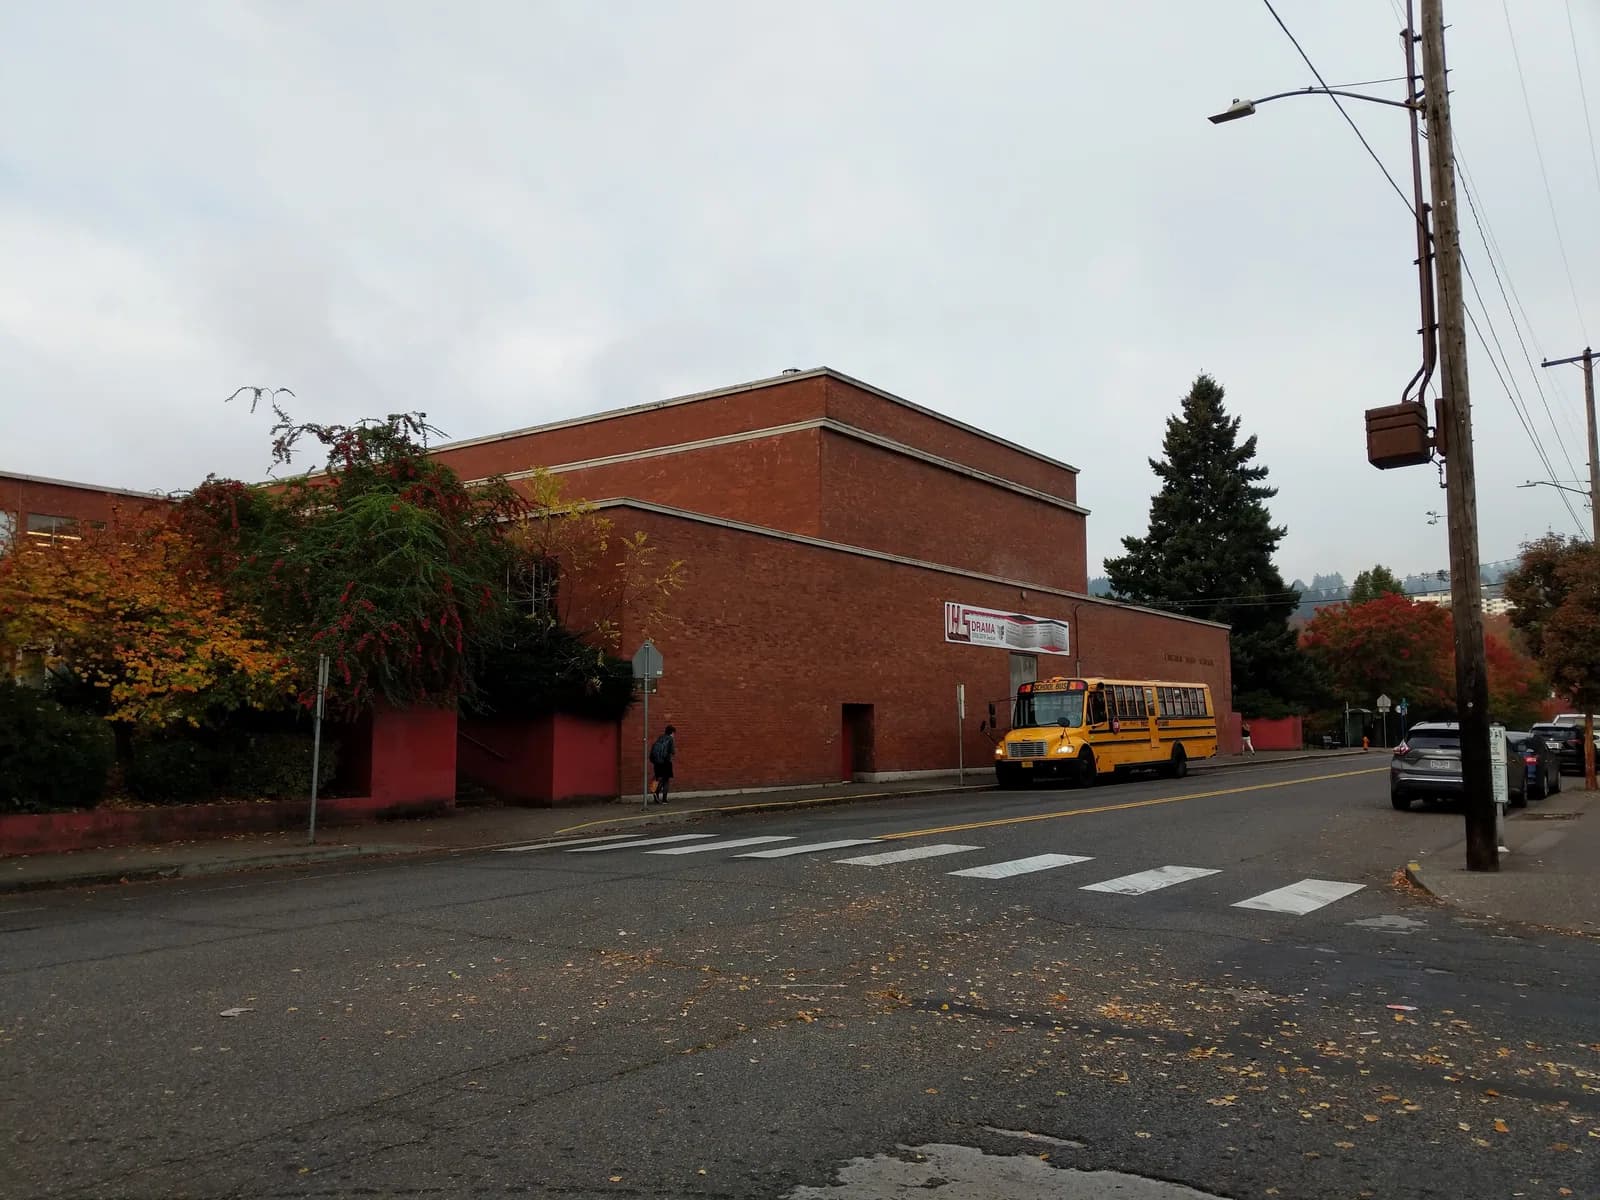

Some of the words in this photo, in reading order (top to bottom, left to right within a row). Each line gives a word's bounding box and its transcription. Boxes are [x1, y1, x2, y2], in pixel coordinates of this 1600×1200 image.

[971, 621, 995, 634] DRAMA
[1034, 682, 1054, 691] SCHOOL
[1055, 681, 1067, 690] BUS
